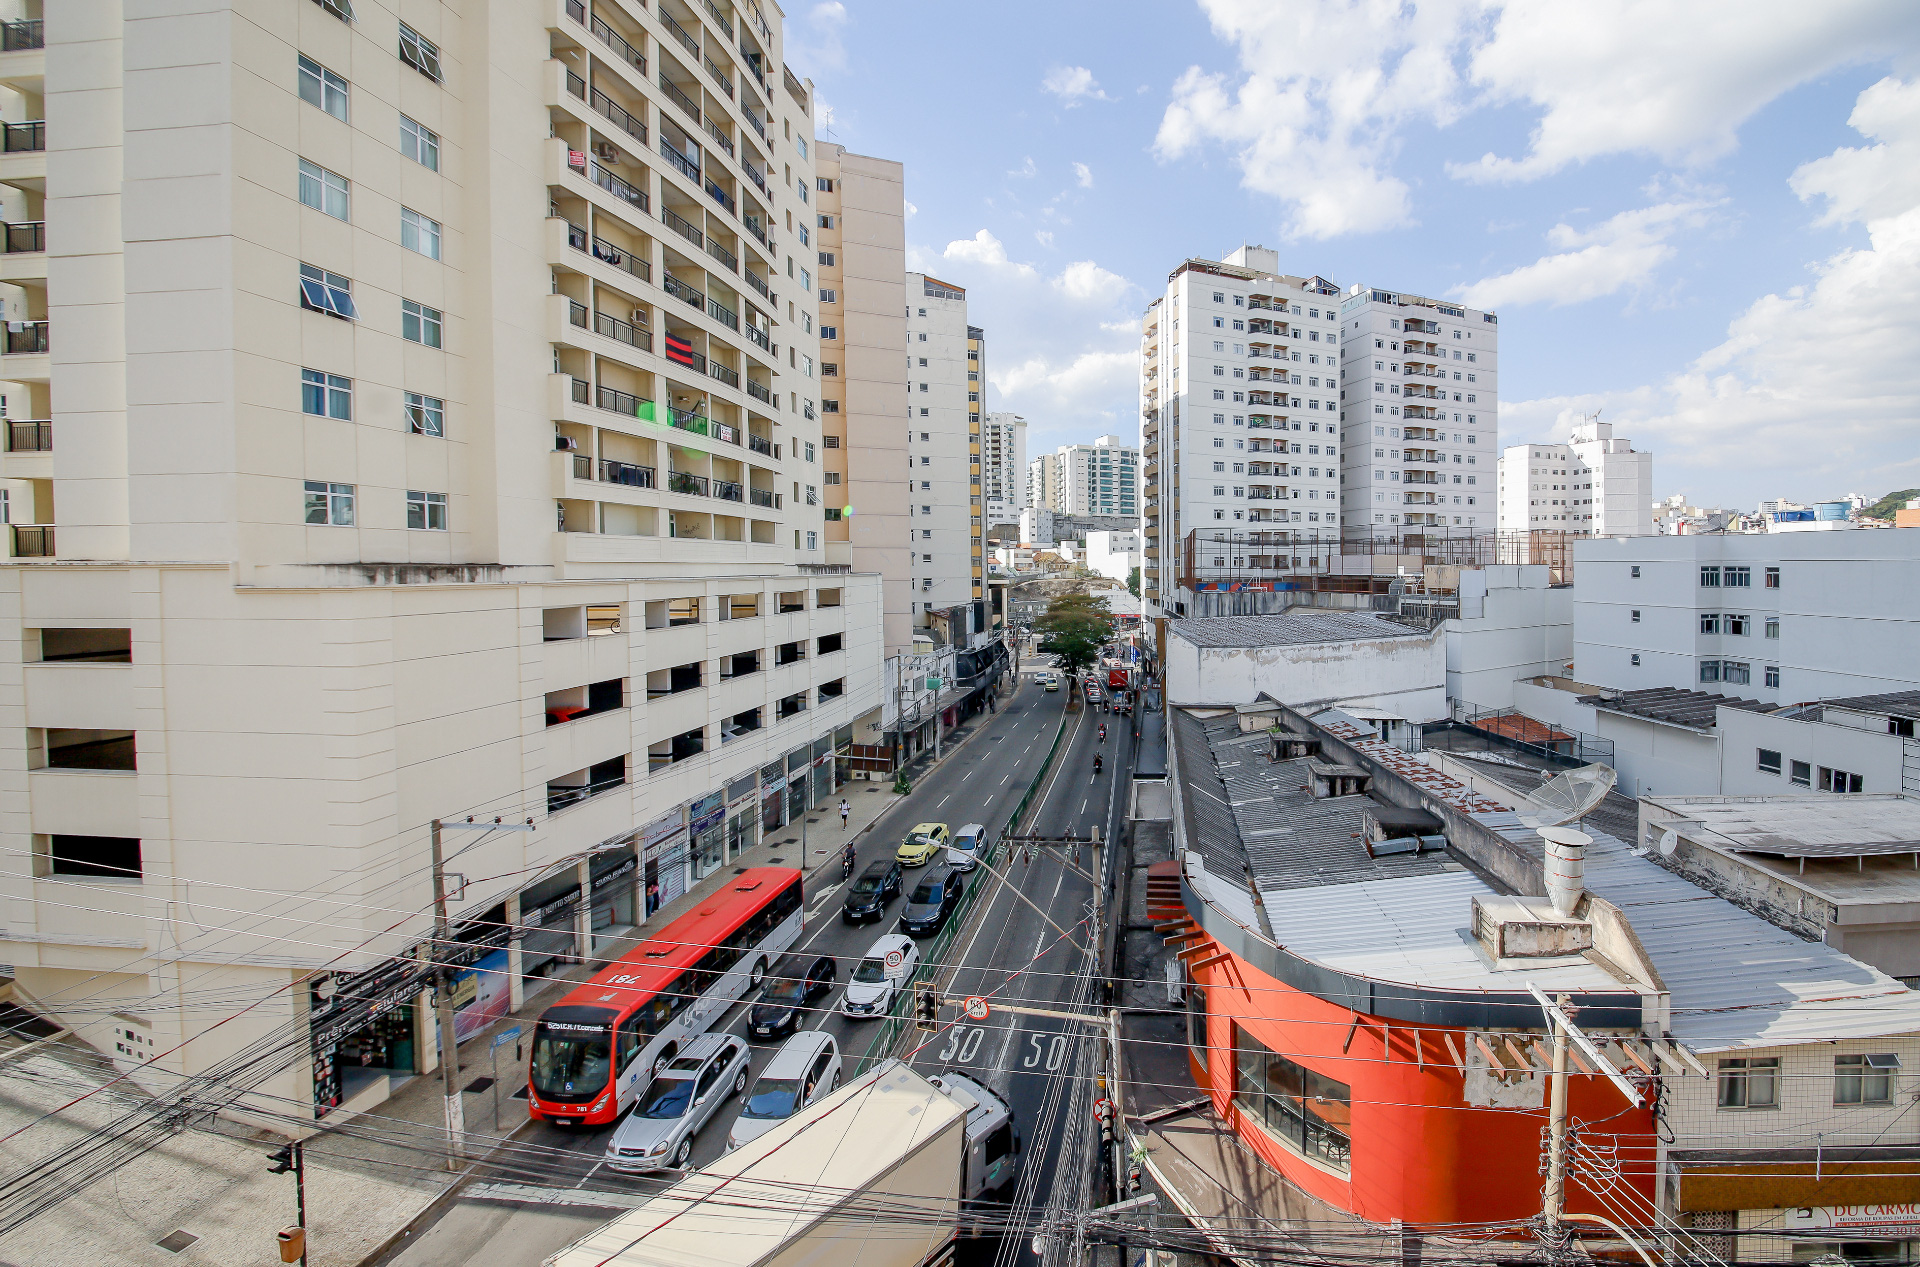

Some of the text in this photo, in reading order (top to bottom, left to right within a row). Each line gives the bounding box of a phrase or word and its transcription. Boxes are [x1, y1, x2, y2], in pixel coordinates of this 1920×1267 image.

[606, 974, 642, 984] 781
[939, 1025, 985, 1062] 50
[1023, 1033, 1068, 1071] 50
[1834, 1205, 1858, 1217] DU
